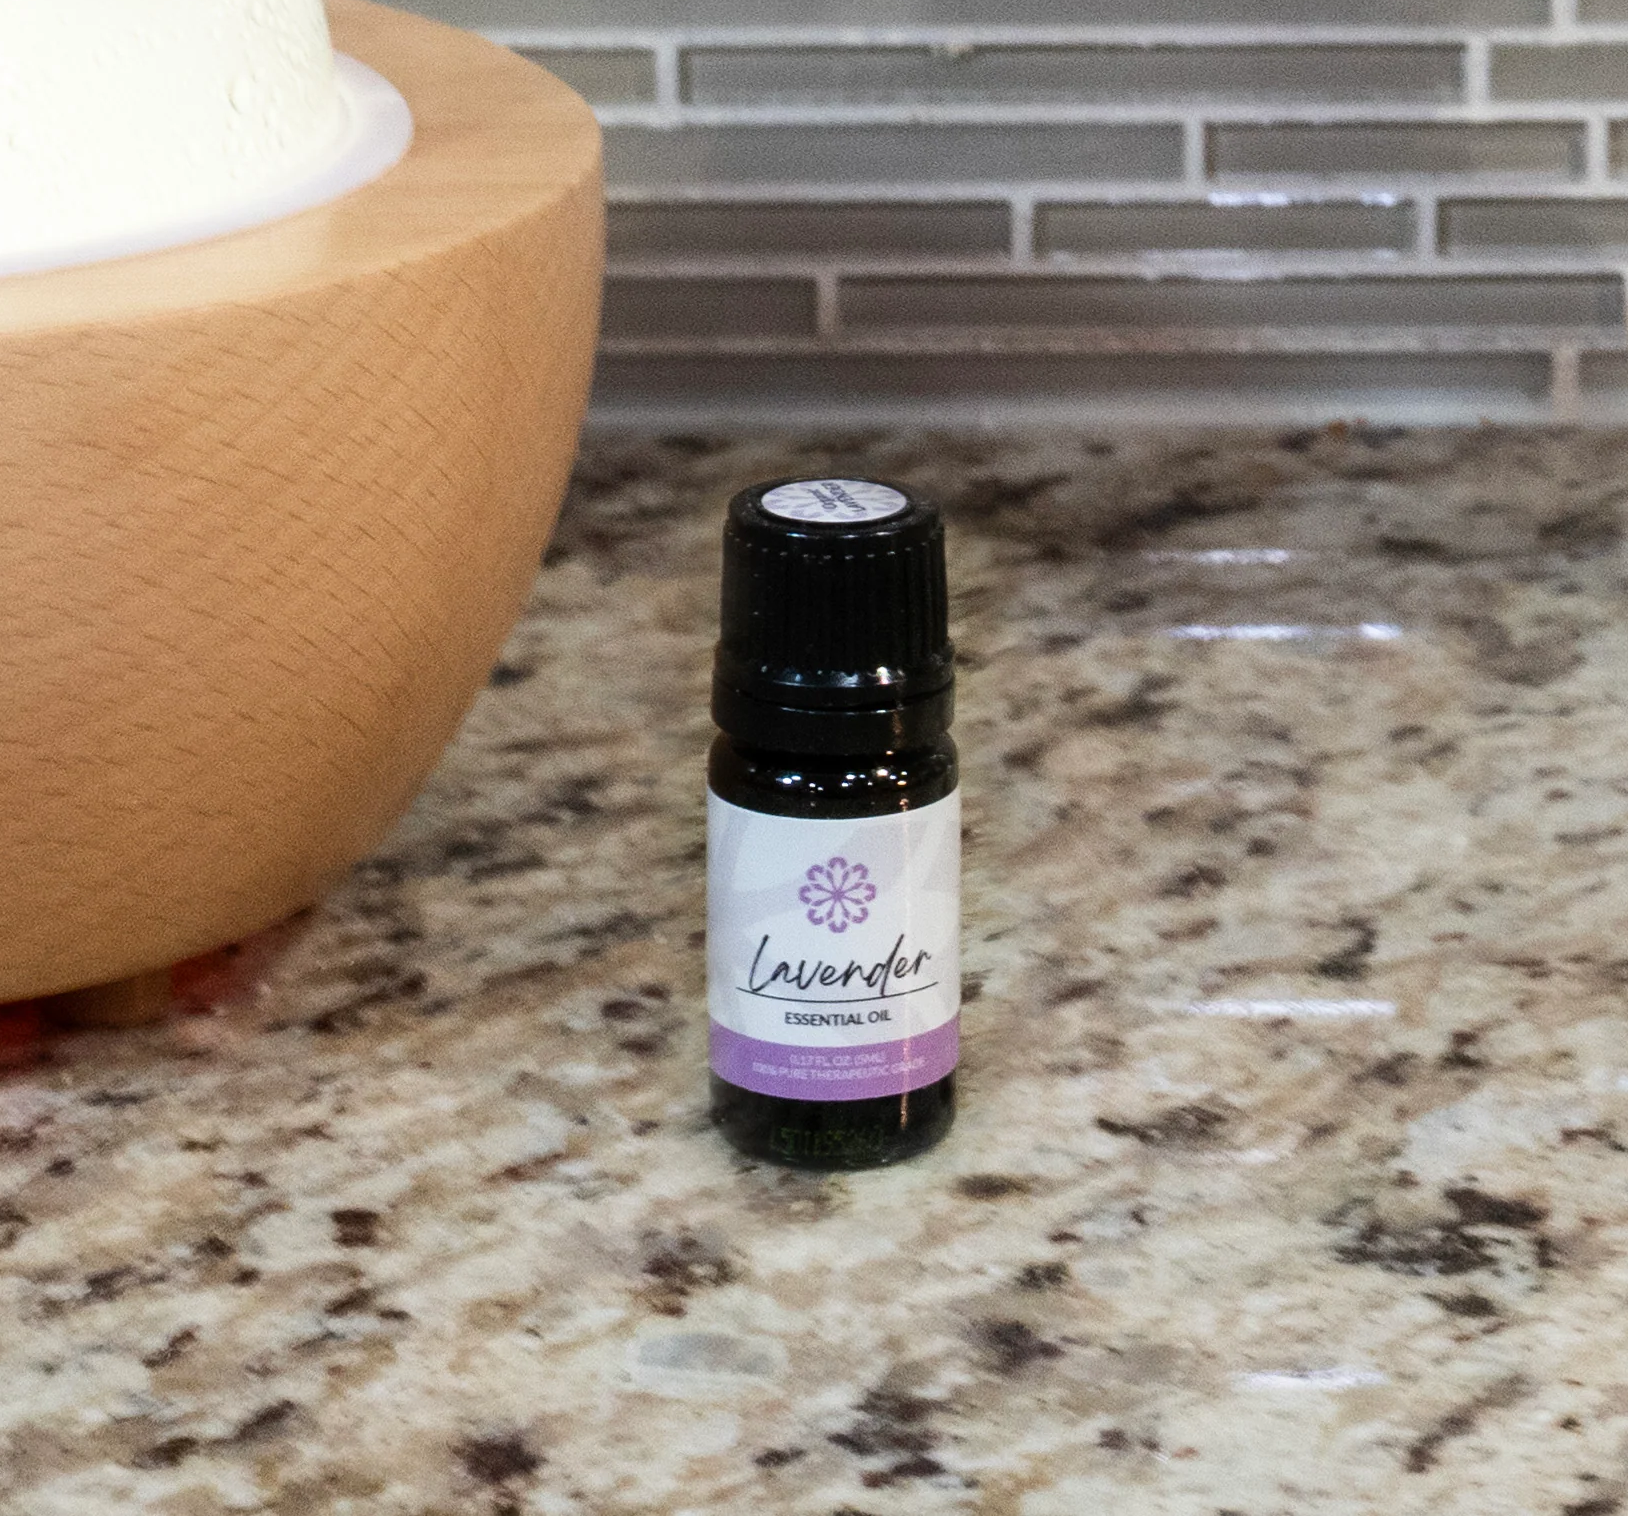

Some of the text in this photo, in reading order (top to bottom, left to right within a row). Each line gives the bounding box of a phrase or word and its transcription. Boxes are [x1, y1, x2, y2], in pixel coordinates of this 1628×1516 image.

[748, 934, 932, 997] Lavender
[784, 1009, 892, 1027] ESSENTIAL OIL
[778, 1066, 808, 1080] PURE
[810, 1064, 890, 1081] THERAPEUTIC
